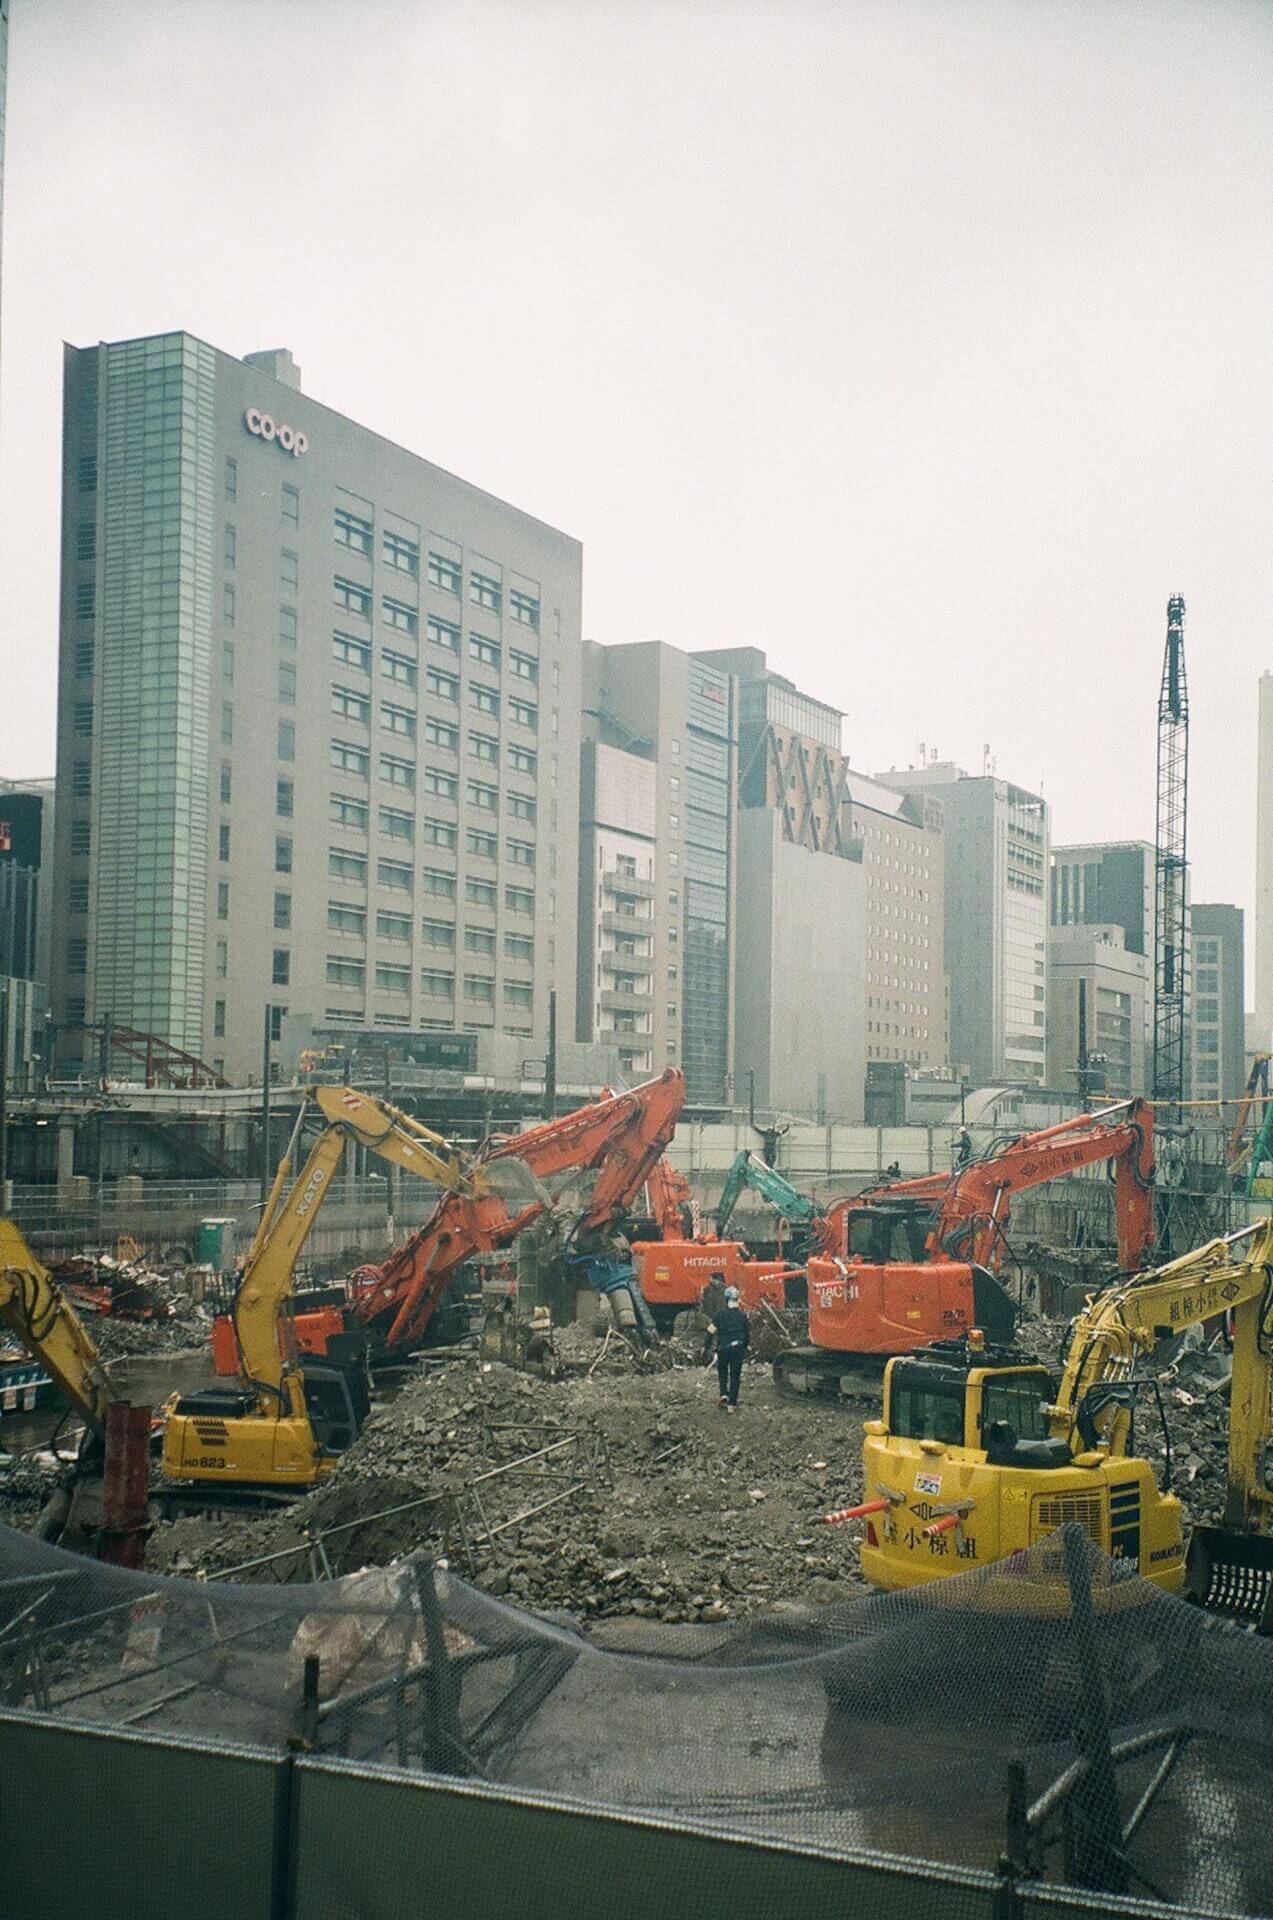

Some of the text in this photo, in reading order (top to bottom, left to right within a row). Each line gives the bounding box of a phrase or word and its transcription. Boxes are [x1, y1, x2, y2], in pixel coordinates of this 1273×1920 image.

[296, 1170, 324, 1216] KATO
[683, 1257, 727, 1267] HITACHI
[812, 1285, 859, 1299] ITACHI
[1150, 1544, 1183, 1562] KOMATSU
